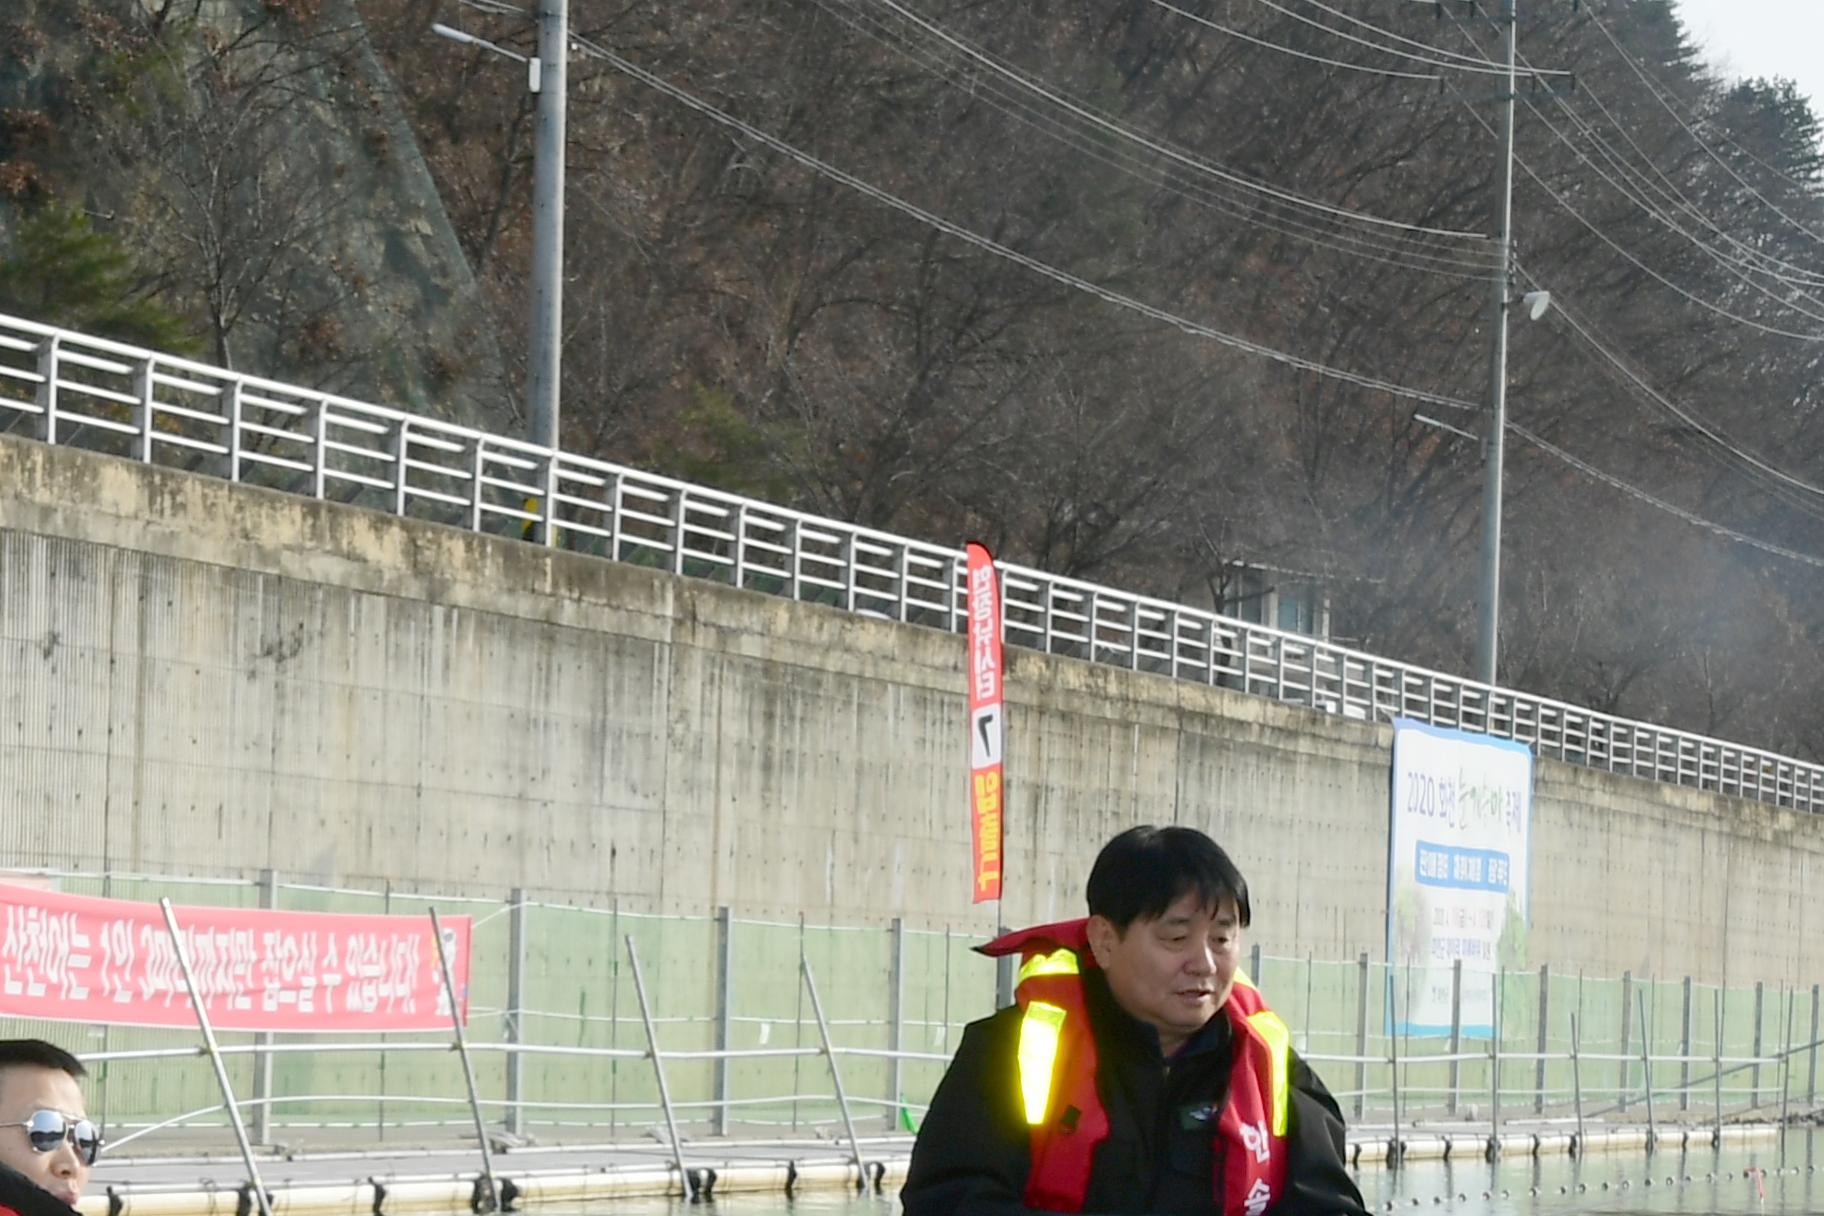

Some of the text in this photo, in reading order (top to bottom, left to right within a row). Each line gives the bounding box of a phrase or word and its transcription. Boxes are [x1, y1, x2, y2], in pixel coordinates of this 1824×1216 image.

[1407, 771, 1436, 818] 2020
[1, 903, 93, 1001] 산천어는
[99, 917, 136, 1005] 1인
[138, 923, 257, 1011] 3마리까지만
[261, 930, 318, 1013] 잡으실
[322, 932, 343, 1014] 수
[345, 932, 422, 1015] 있습니다!
